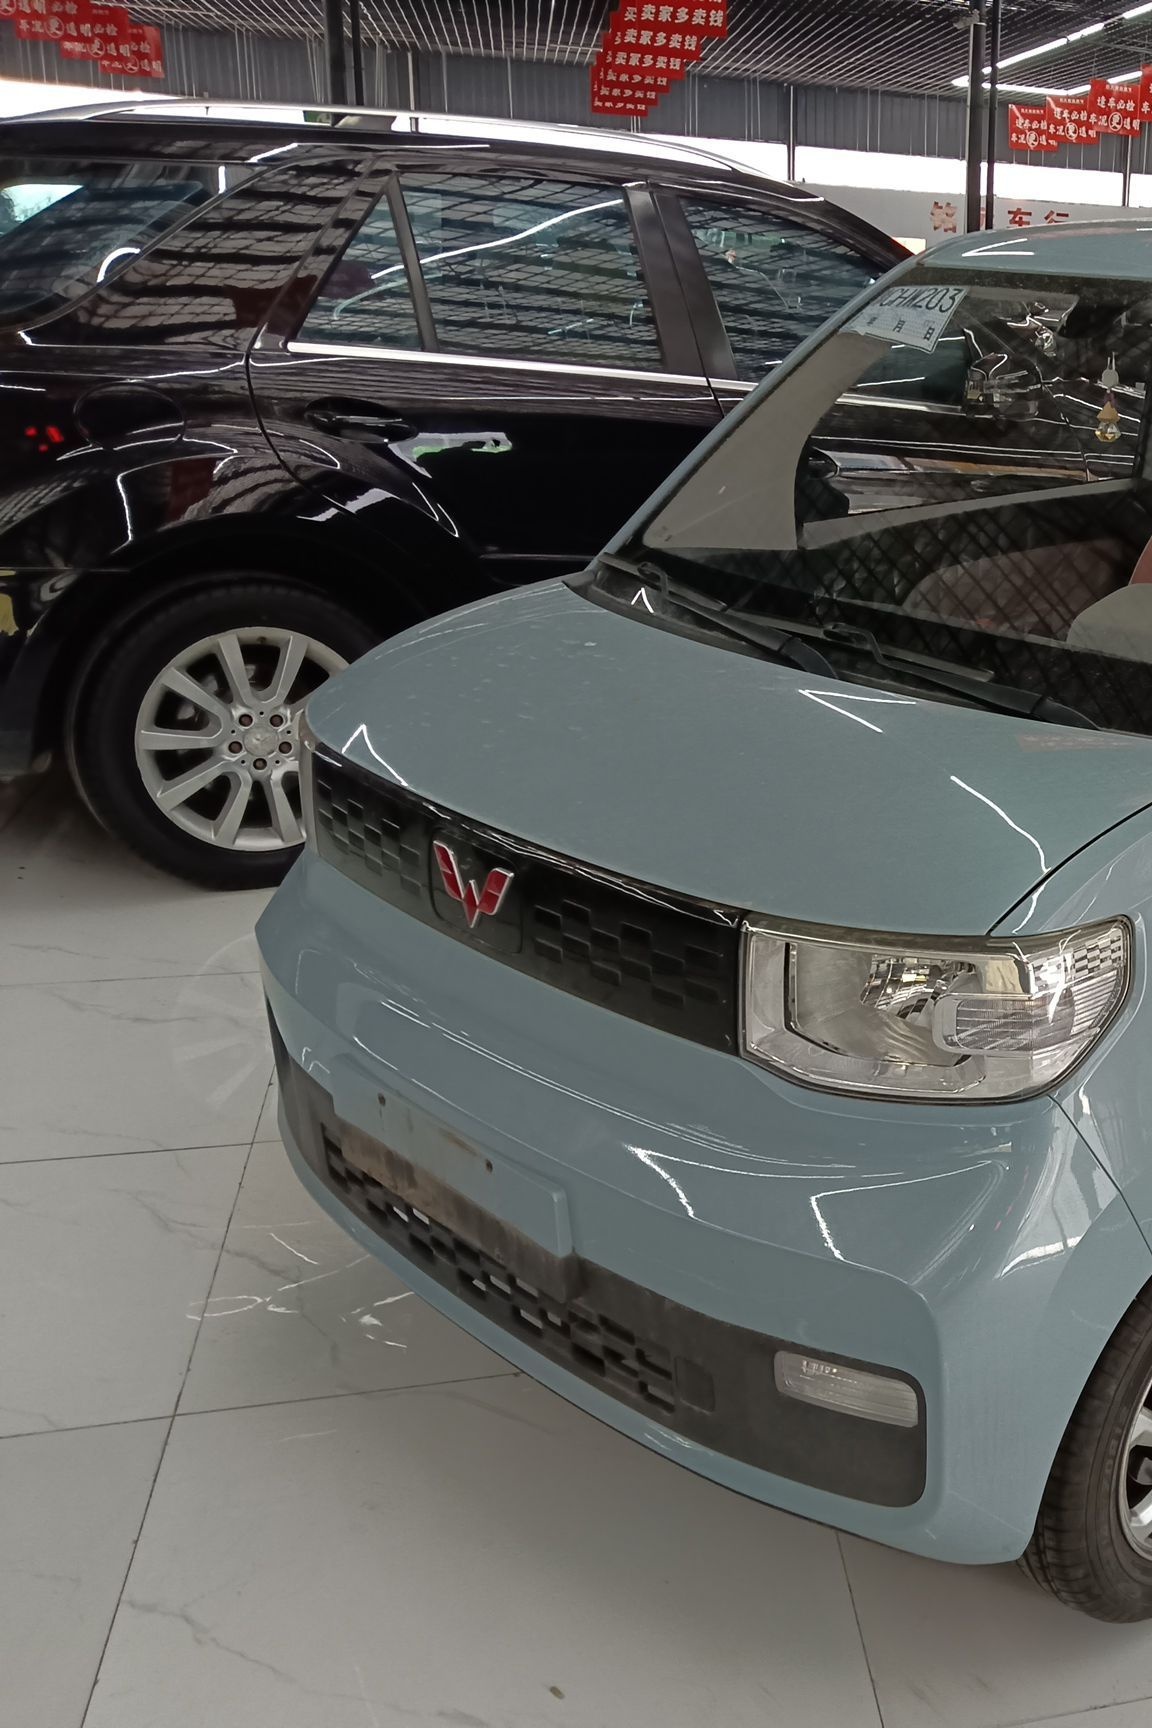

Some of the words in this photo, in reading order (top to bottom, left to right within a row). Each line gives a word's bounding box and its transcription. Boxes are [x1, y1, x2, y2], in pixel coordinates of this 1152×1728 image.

[641, 4, 724, 27] 卖家多卖钱
[624, 28, 698, 51] 卖家多卖钱
[1048, 122, 1097, 140] 车况更透明
[1089, 112, 1140, 131] 车况更透明
